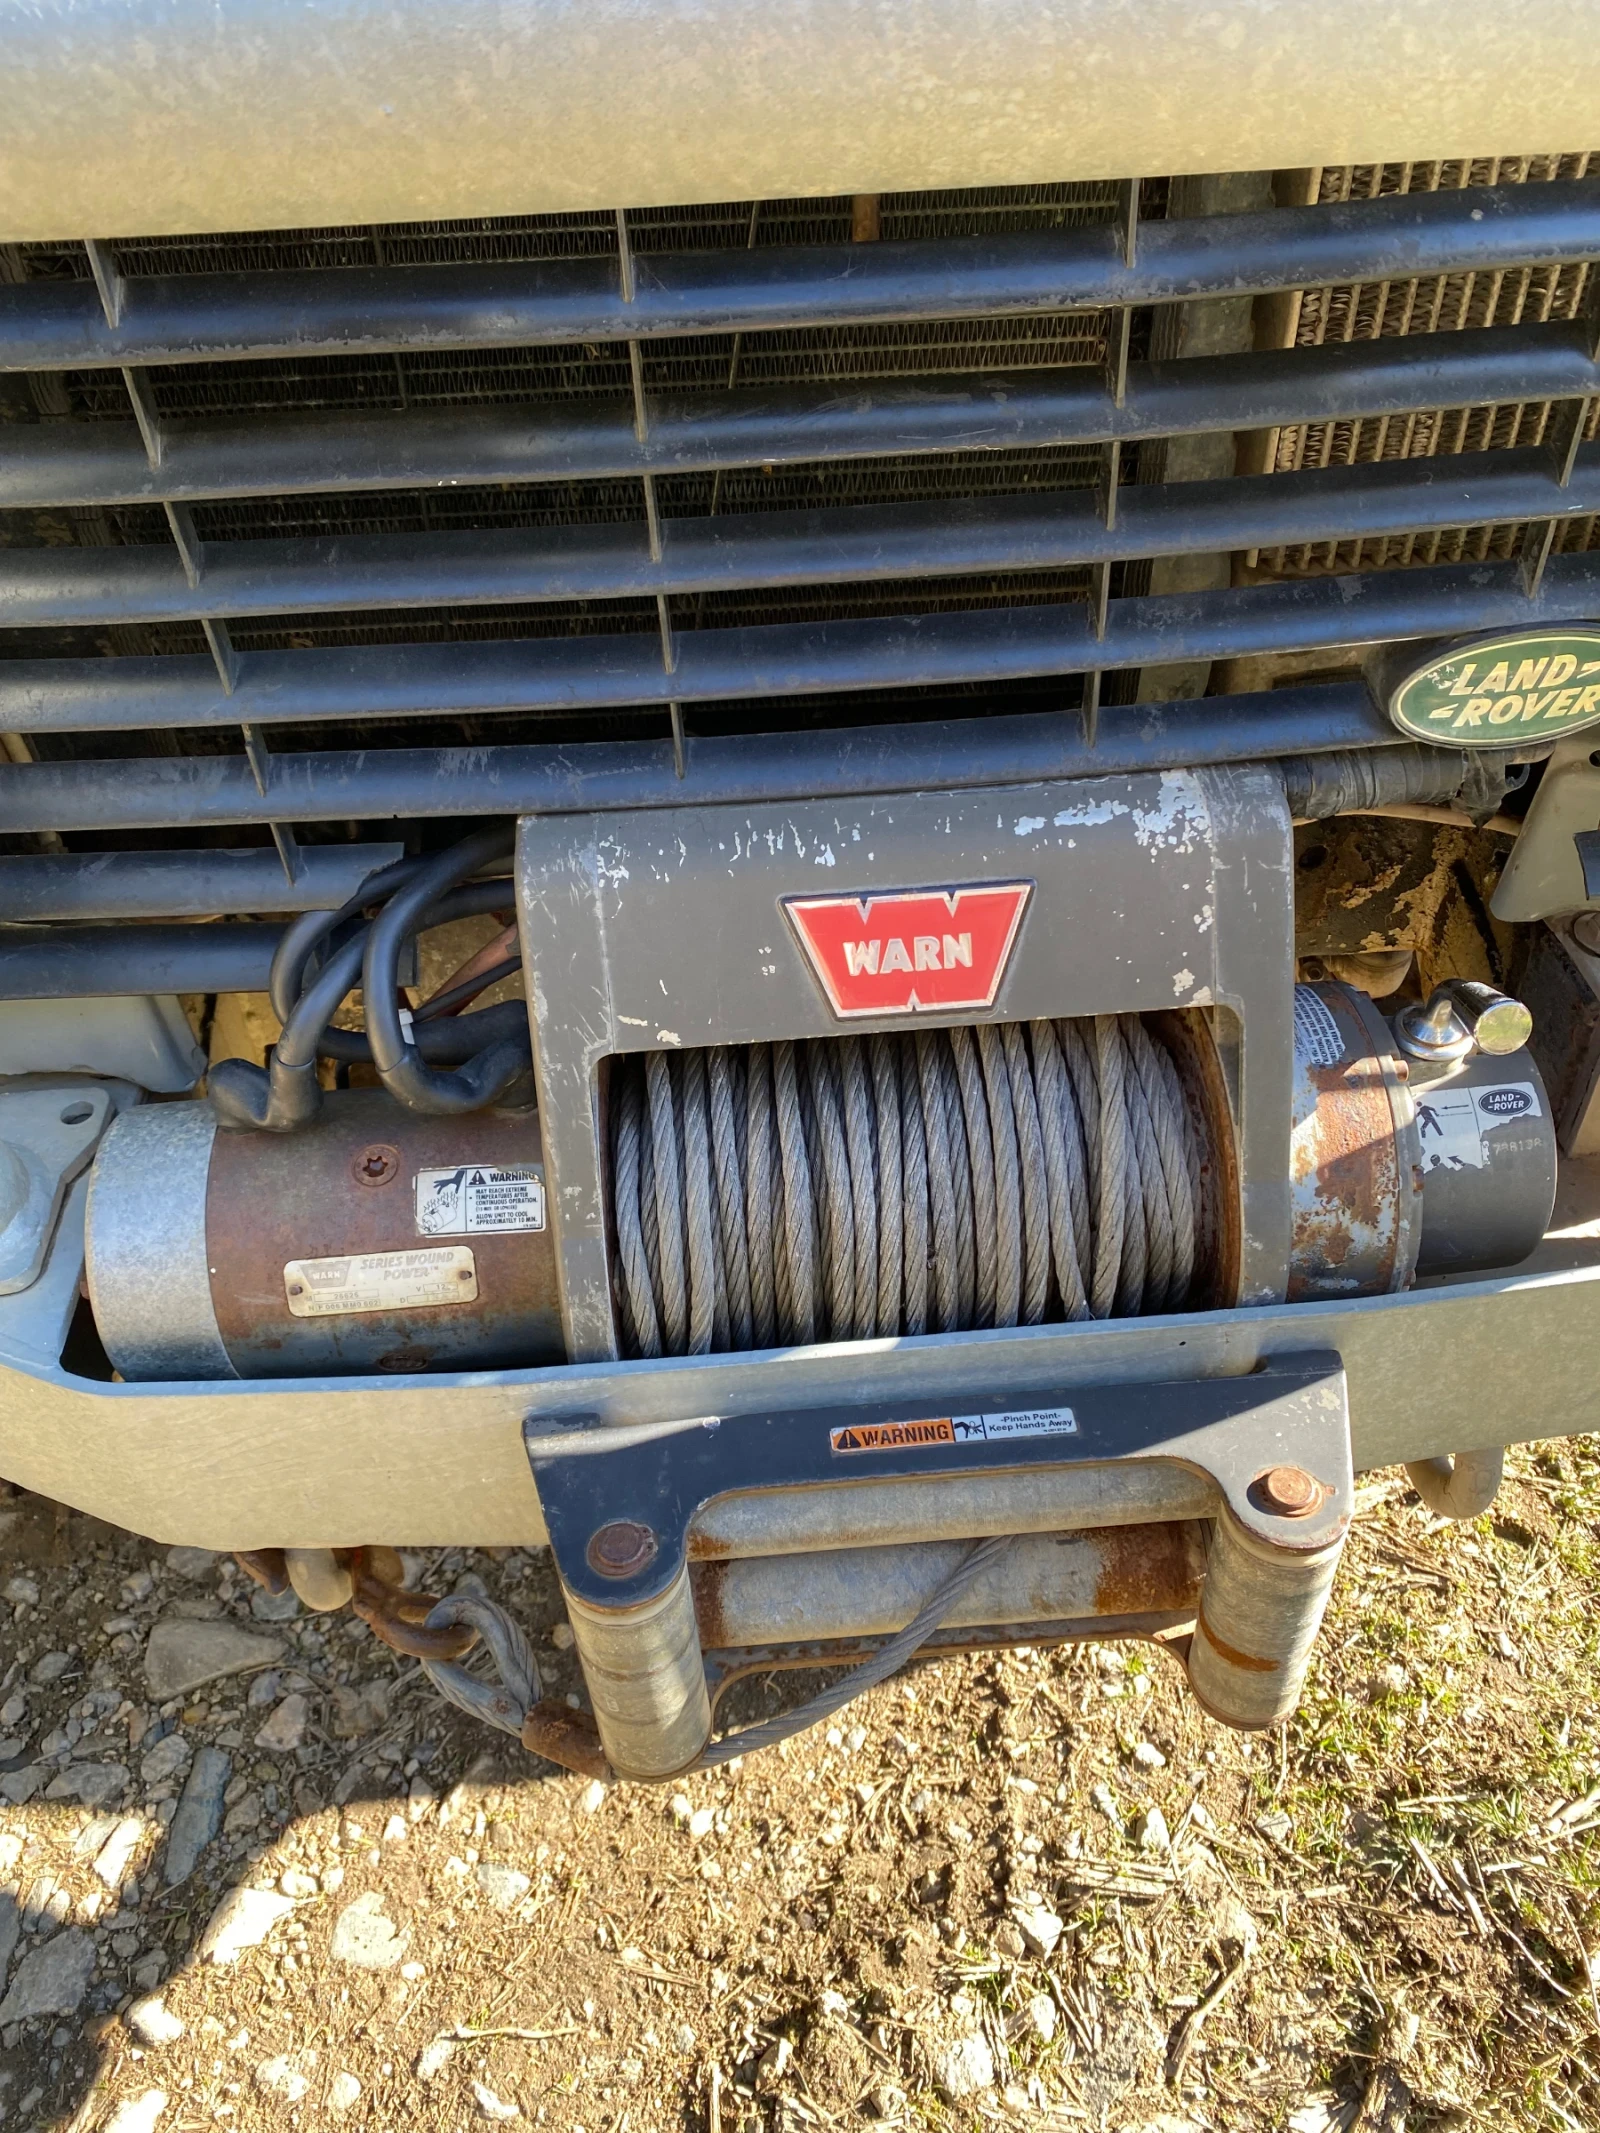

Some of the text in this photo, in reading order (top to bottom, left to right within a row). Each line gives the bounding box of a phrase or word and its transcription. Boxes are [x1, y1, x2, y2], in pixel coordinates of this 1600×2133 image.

[842, 932, 973, 977] WARN
[489, 1171, 535, 1183] WARNING
[360, 1252, 454, 1270] SERIES WOUND
[312, 1270, 341, 1281] WARN
[989, 1419, 1073, 1432] Keep Hands Away
[861, 1424, 949, 1447] WARNING
